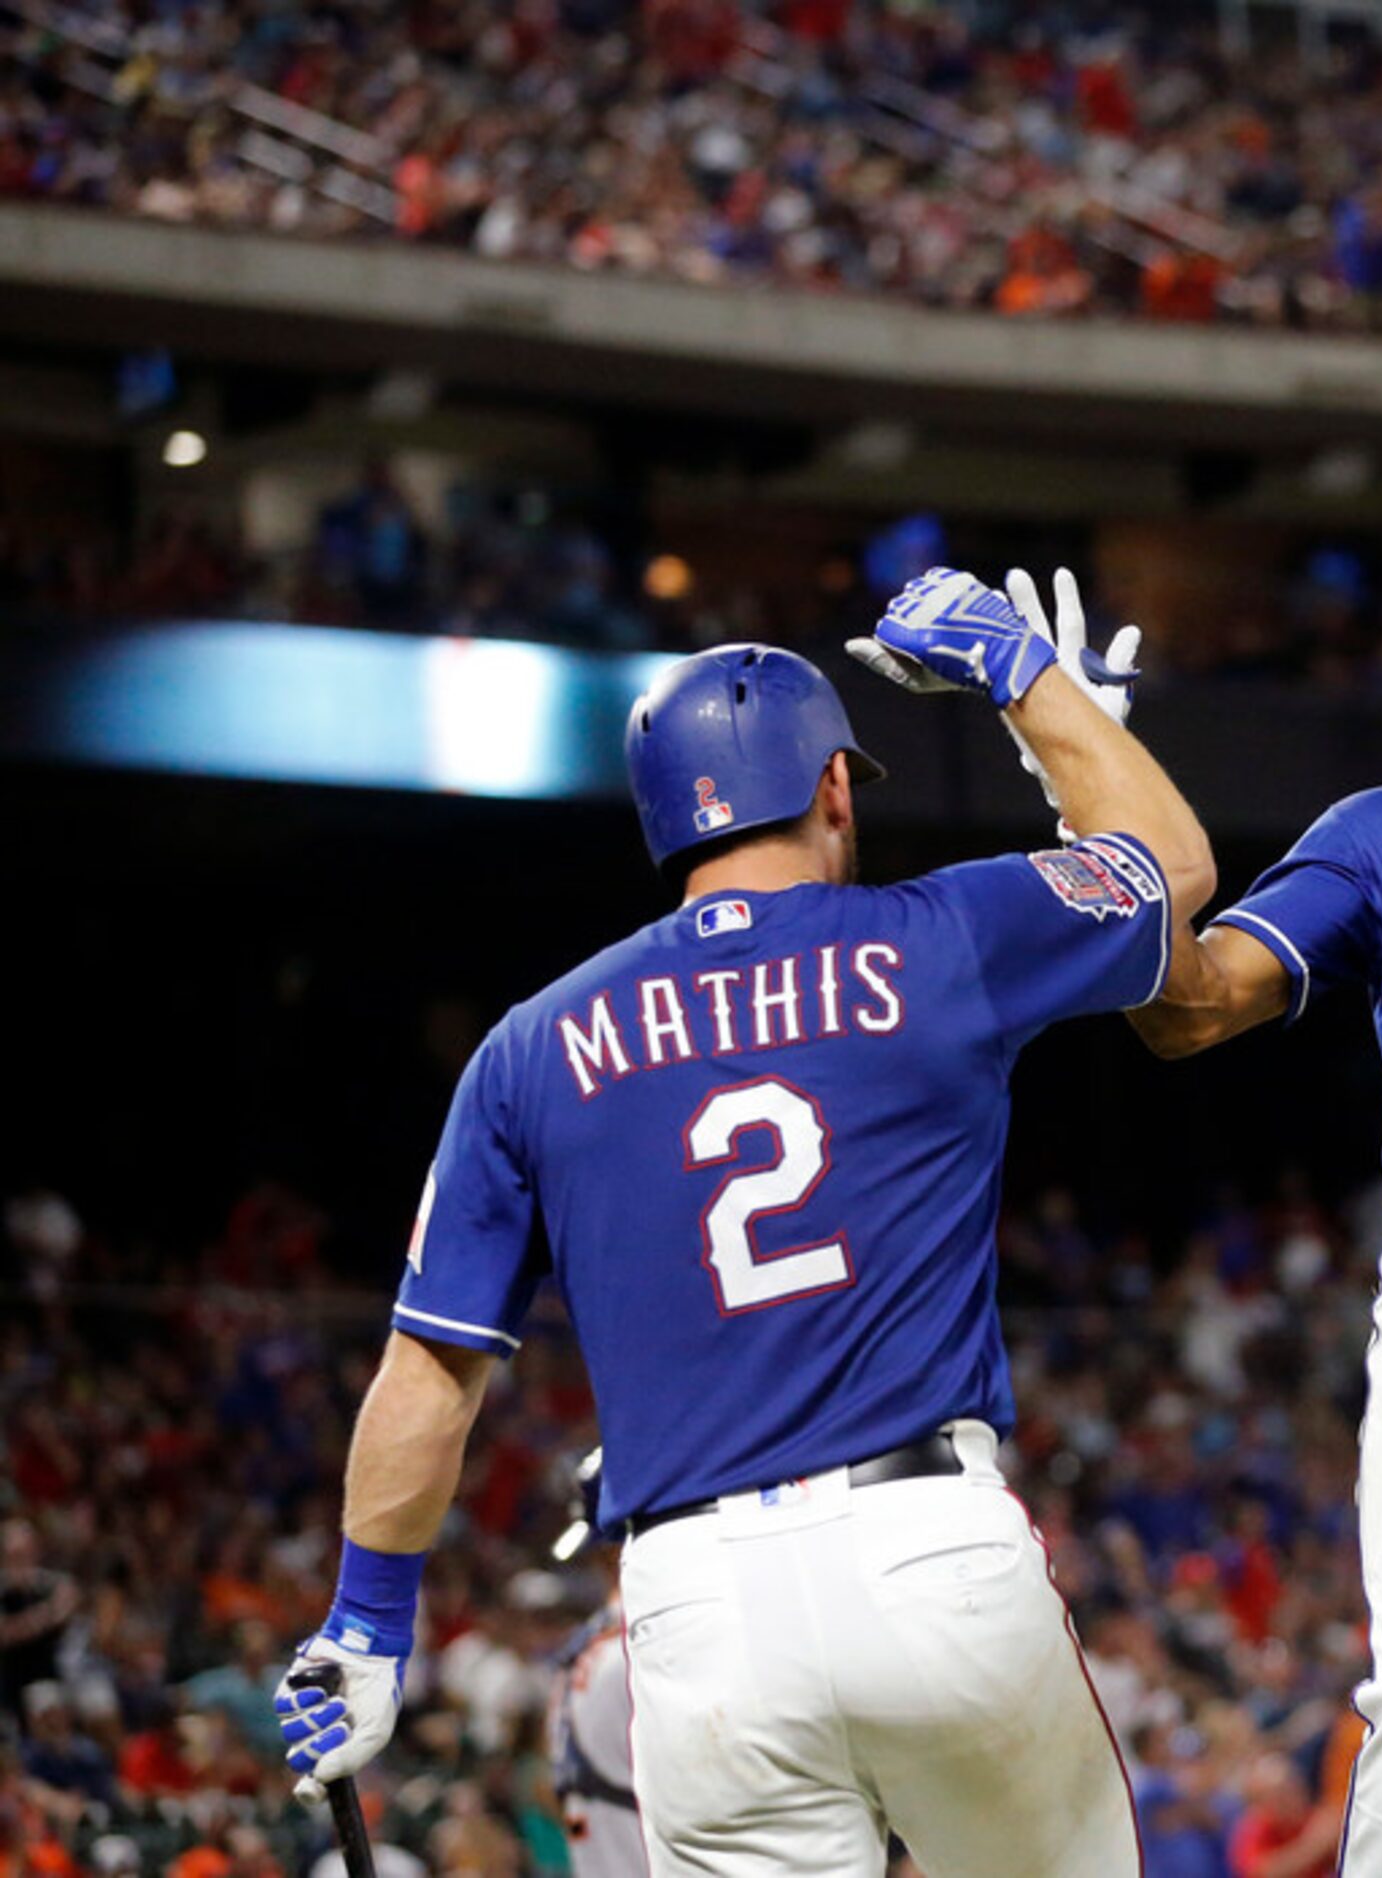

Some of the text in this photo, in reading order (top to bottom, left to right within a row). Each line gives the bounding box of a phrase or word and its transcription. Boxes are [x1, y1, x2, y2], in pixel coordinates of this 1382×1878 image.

[694, 776, 719, 808] 2
[556, 942, 904, 1101] MATHIS
[683, 1073, 857, 1318] 2
